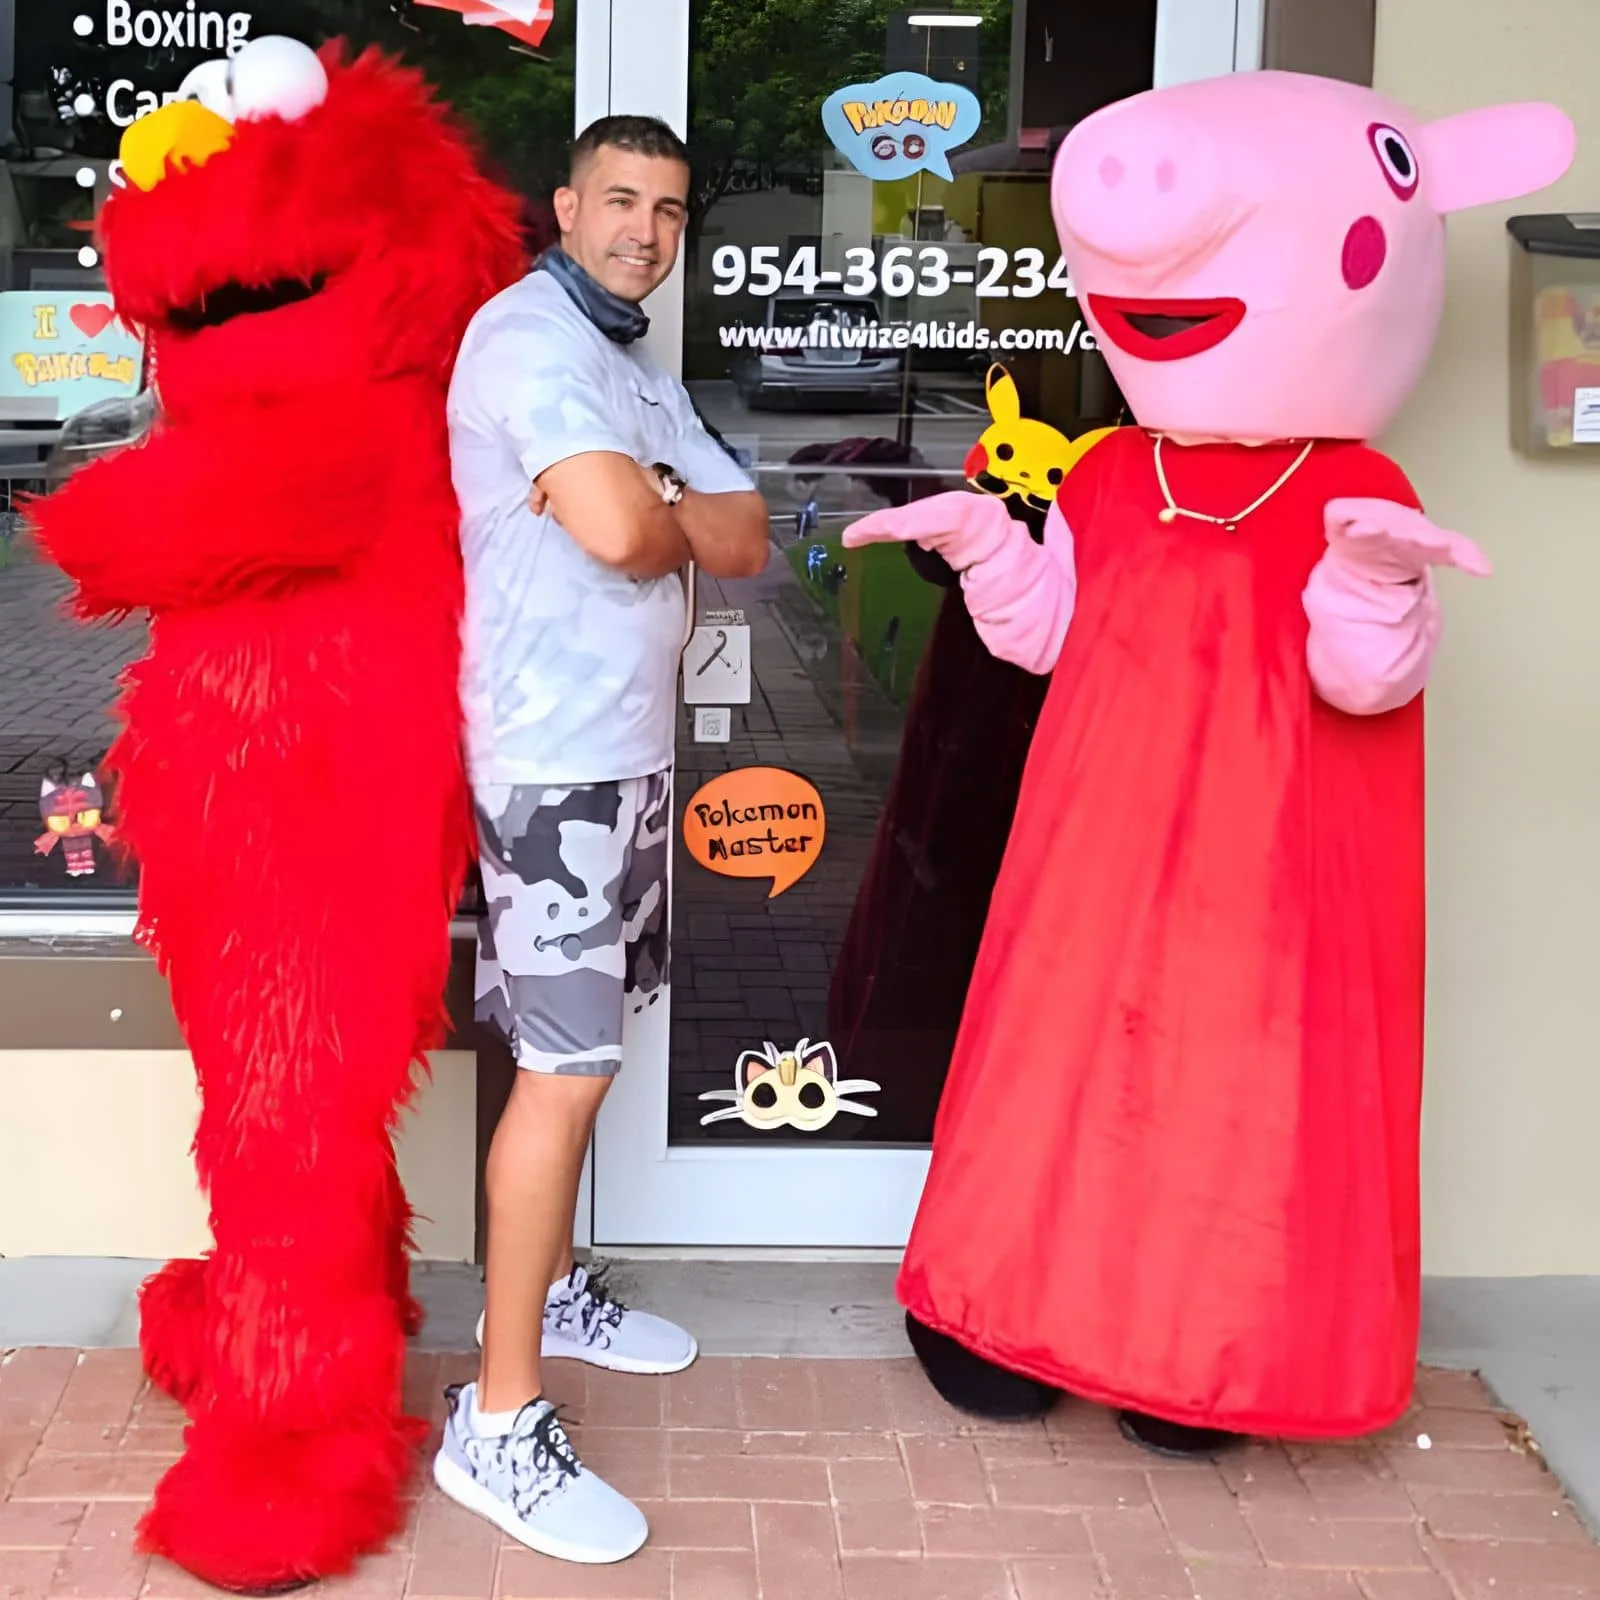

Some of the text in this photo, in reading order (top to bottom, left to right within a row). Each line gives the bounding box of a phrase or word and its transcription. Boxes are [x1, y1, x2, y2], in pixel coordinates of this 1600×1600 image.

[106, 0, 251, 58] Boxing
[718, 318, 1101, 355] www.fitwize4kids.com/c
[708, 828, 813, 860] Master
